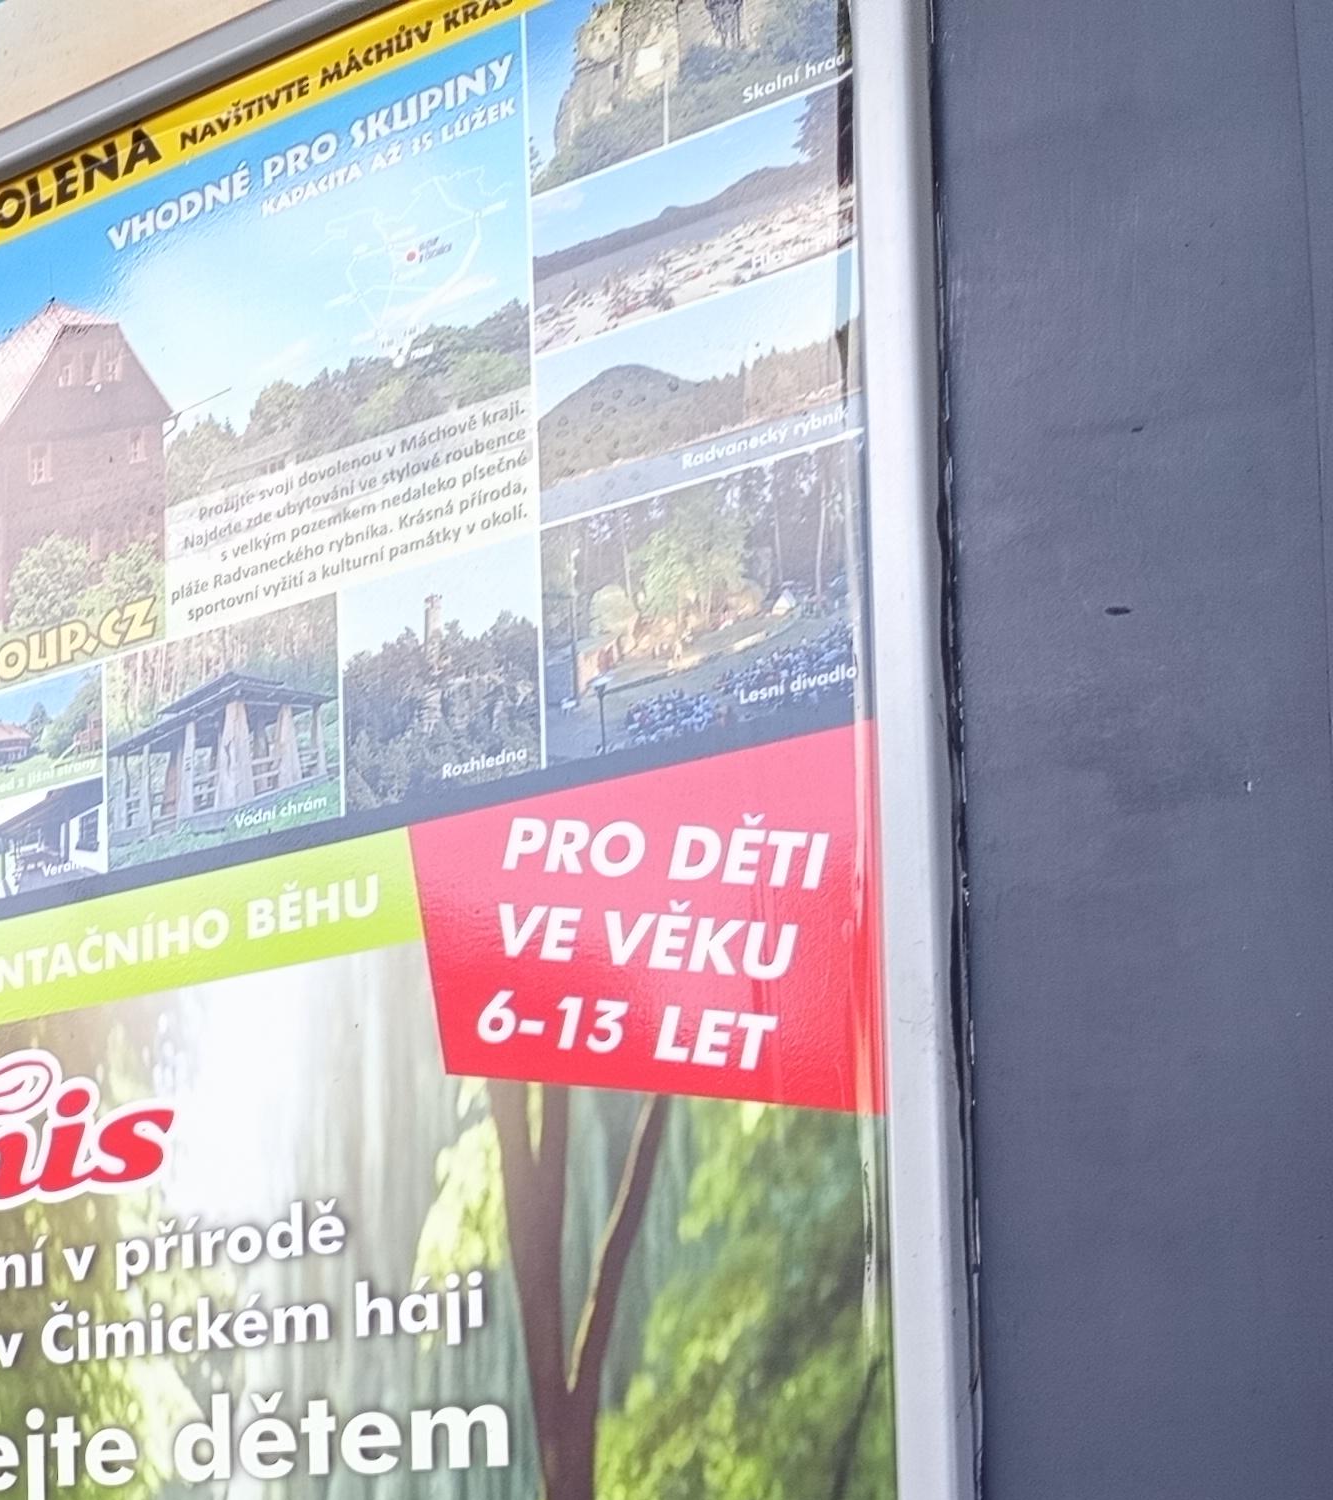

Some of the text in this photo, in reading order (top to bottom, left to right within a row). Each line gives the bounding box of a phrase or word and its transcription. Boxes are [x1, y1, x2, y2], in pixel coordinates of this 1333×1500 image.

[179, 75, 310, 152] NAVŠTIVTE
[319, 20, 433, 89] MÁCHŮV
[742, 50, 846, 104] Skalní hrad
[106, 53, 514, 252] VHODNÉ PRO SKUPINY
[261, 163, 363, 218] KAPACITA
[298, 449, 382, 487] dovolenou
[400, 415, 477, 453] Máchově
[681, 424, 789, 470] Radvanecký
[183, 521, 242, 550] Najdete
[276, 479, 355, 516] ubytování
[359, 476, 377, 492] ve
[382, 452, 440, 485] stylové
[445, 428, 526, 464] roubence
[232, 531, 286, 558] velkým
[291, 502, 376, 542] pozemkem
[381, 477, 457, 510] nedaleko
[462, 449, 528, 487] písečné
[171, 481, 528, 605] pláže Radvaneckého rybníka. Krásná příroda,
[187, 584, 259, 622] sportovní
[263, 570, 303, 597] vyžití
[321, 546, 384, 580] kulturní
[389, 527, 461, 561] památky
[480, 502, 528, 531] okolí.
[739, 663, 858, 705] Lesní divadlo
[441, 745, 528, 780] Rozhledna
[234, 795, 327, 829] Vodní chrám
[501, 812, 830, 891] PRO DĚTI
[247, 873, 380, 954] BĚHU
[497, 901, 797, 981] VE VĚKU
[476, 1003, 780, 1071] 6-13 LET
[63, 1246, 97, 1282] v
[115, 1197, 346, 1289] přírodě
[42, 1300, 329, 1364] Čimickém
[355, 1274, 484, 1345] háji
[174, 1391, 509, 1485] dětem
